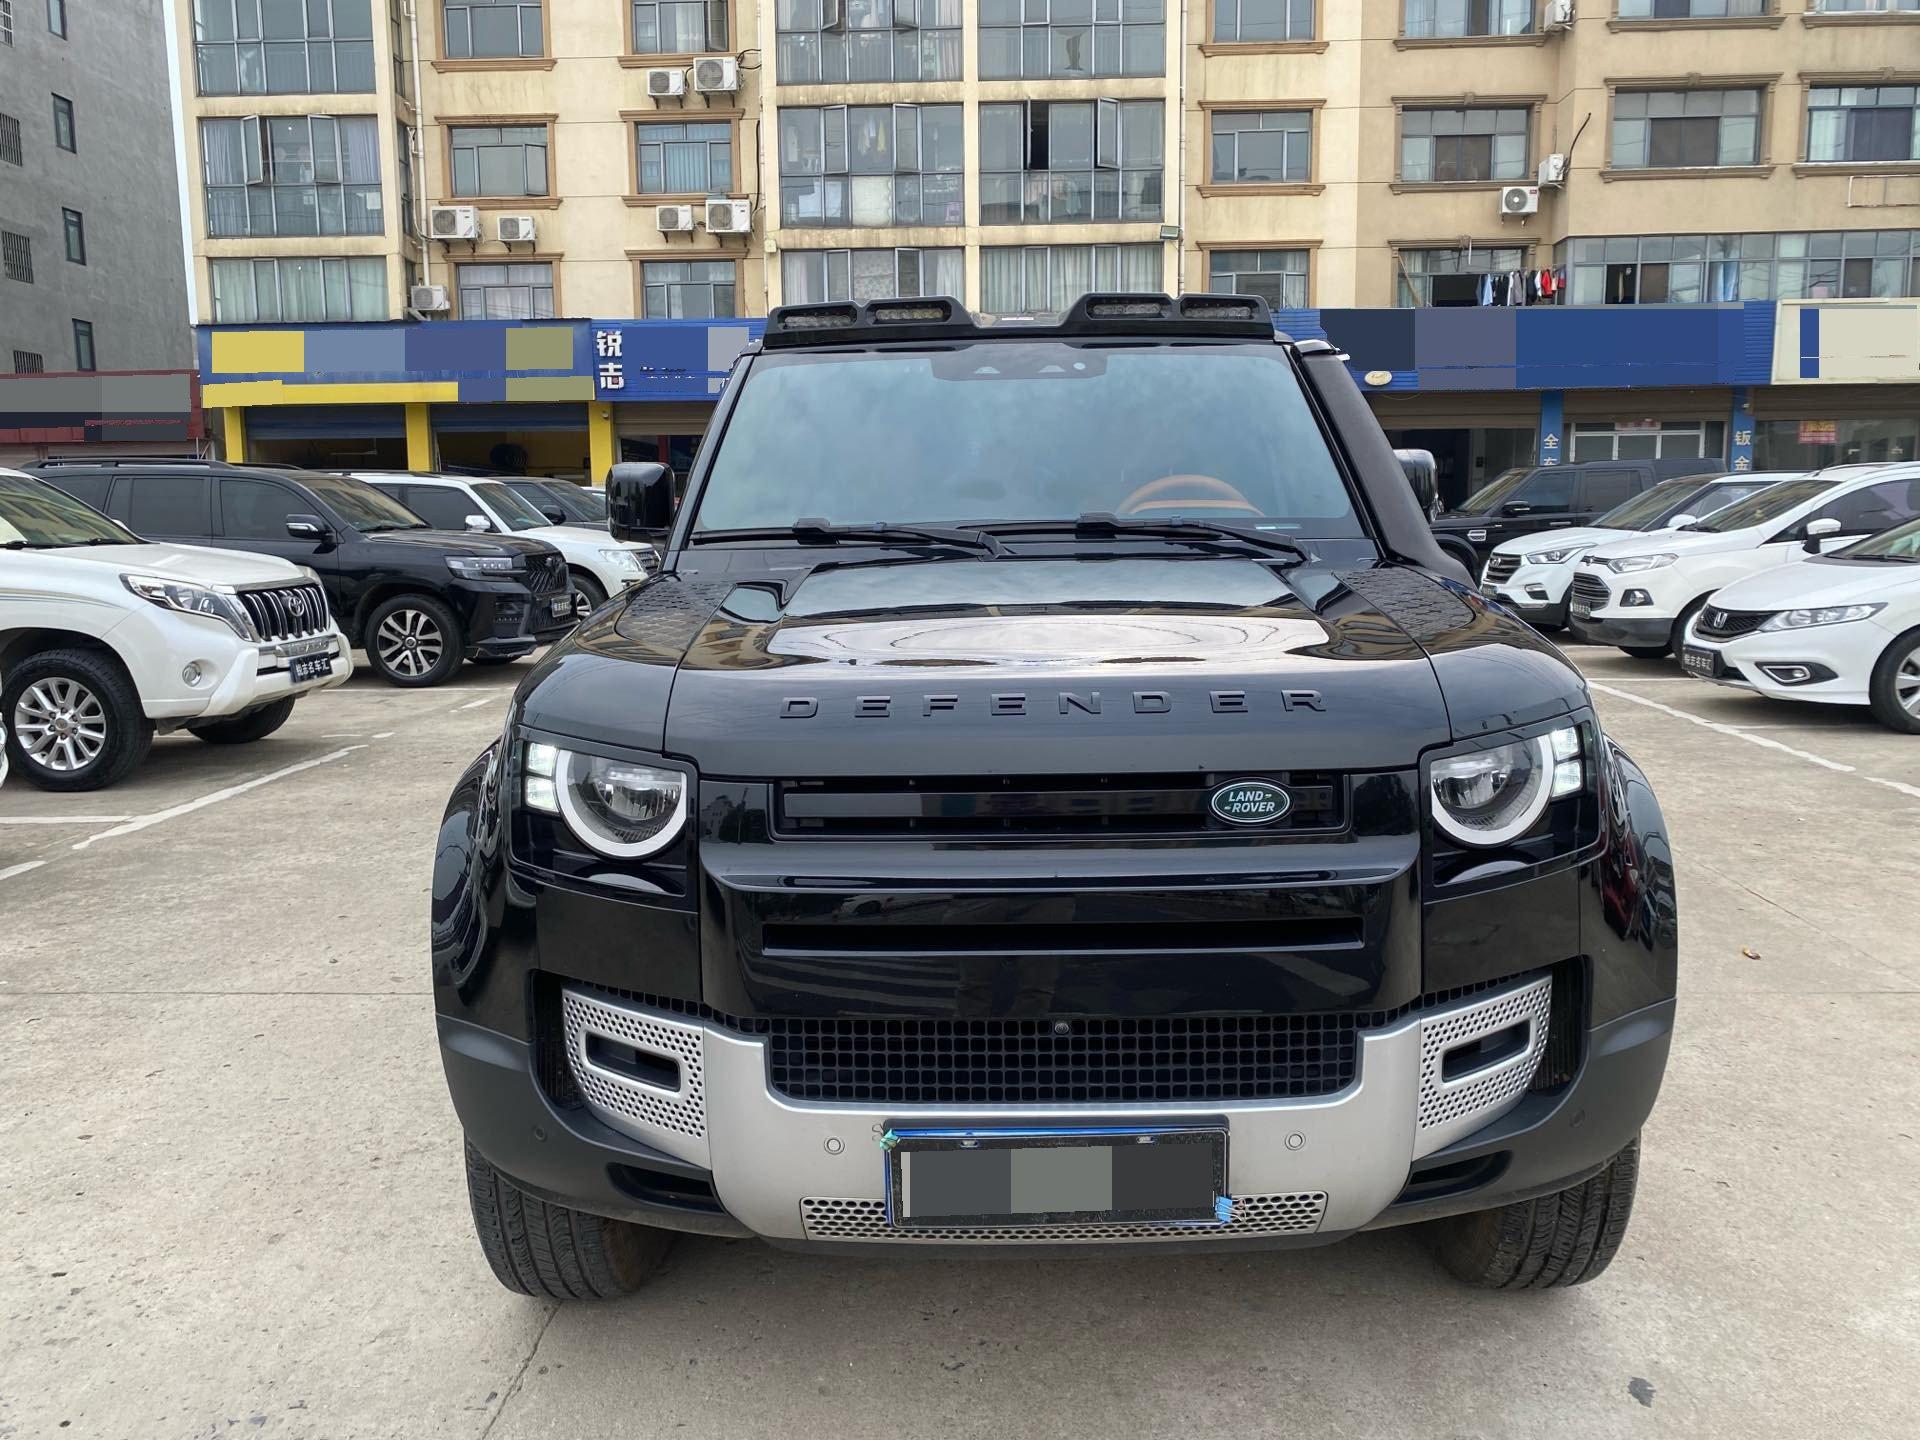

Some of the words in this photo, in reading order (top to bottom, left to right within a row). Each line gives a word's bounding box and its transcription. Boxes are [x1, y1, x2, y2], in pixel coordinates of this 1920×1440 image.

[596, 330, 625, 390] 锐志
[1734, 430, 1751, 471] 钣金
[780, 689, 1327, 719] DEFENDER
[1228, 790, 1264, 802] LAND
[1231, 801, 1276, 813] ROVER
